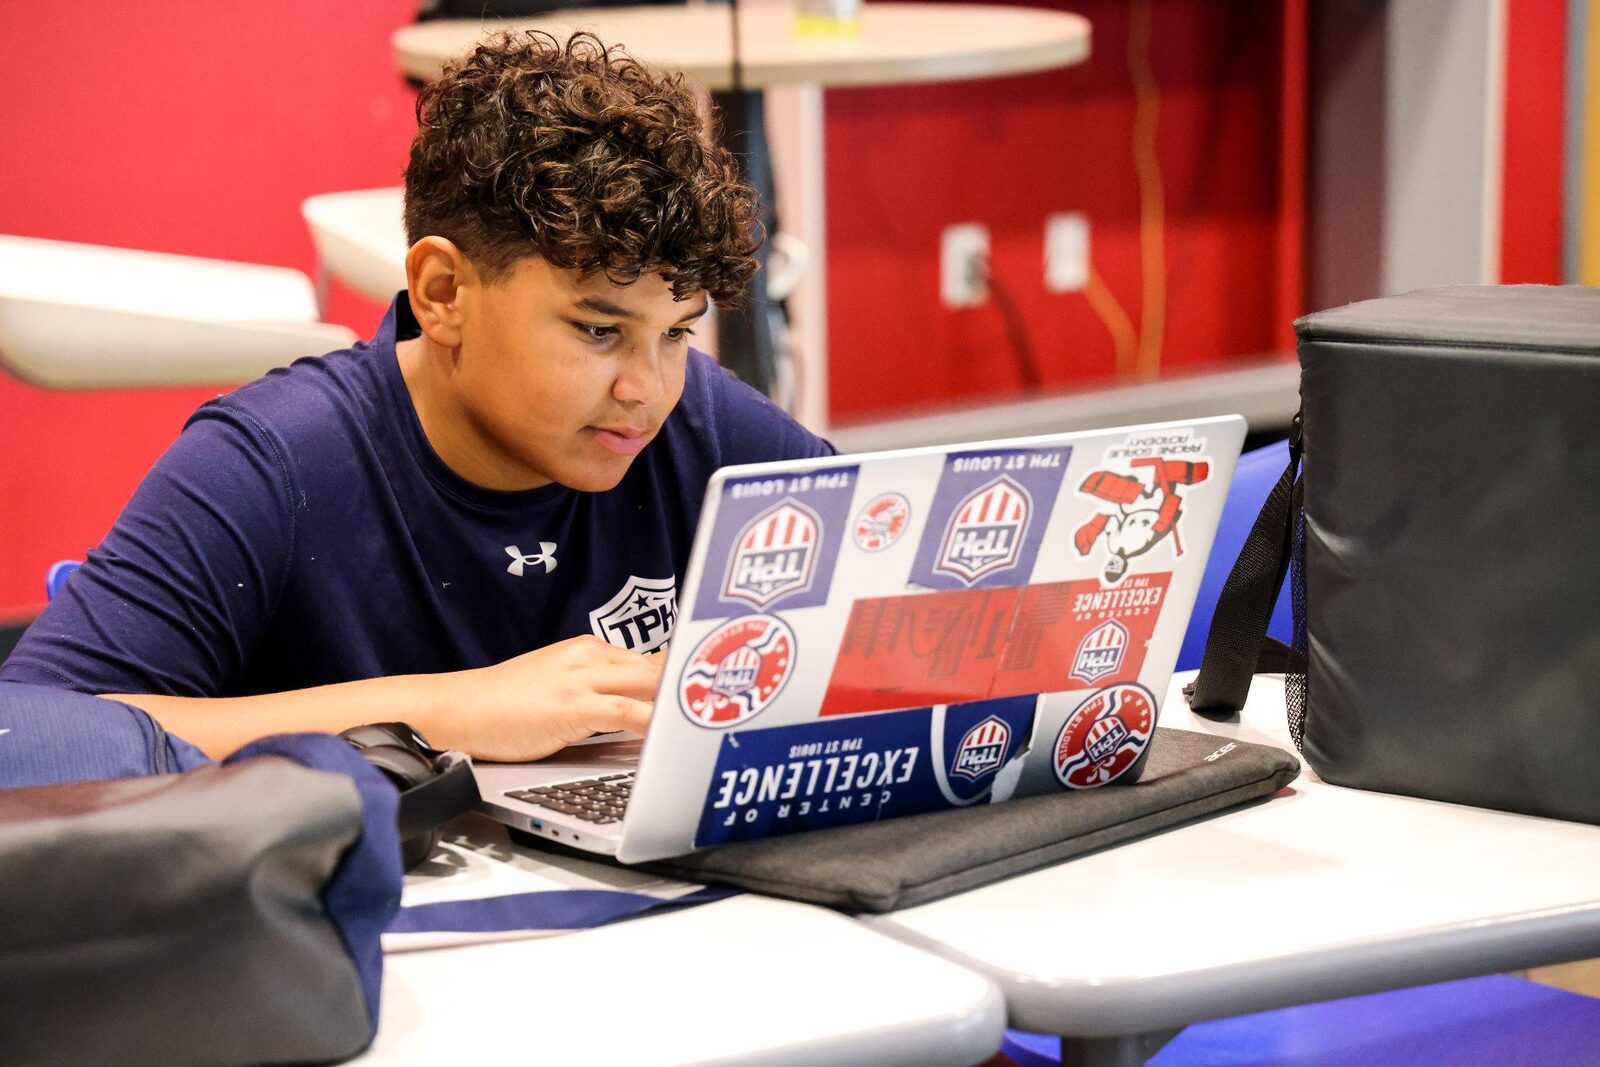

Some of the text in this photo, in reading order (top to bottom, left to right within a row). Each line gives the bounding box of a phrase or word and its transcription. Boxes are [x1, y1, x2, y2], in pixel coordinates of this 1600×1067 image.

[953, 453, 1061, 473] TPH ST LOUIS
[731, 472, 849, 500] TPH ST LOUIS
[951, 529, 1009, 558] TPH
[735, 551, 802, 585] TPH
[1072, 587, 1163, 613] EXCELLENCE
[608, 598, 675, 649] TPH
[1075, 607, 1150, 621] CENTER OF
[1078, 649, 1116, 669] TPH
[1083, 698, 1103, 715] TPH
[788, 737, 864, 759] TPH ST LOUIS
[1091, 729, 1123, 757] TPH
[1203, 742, 1238, 762] acer
[960, 747, 997, 767] TPH
[714, 747, 919, 809] EXCELLENCE
[723, 790, 891, 826] CENTER OF
